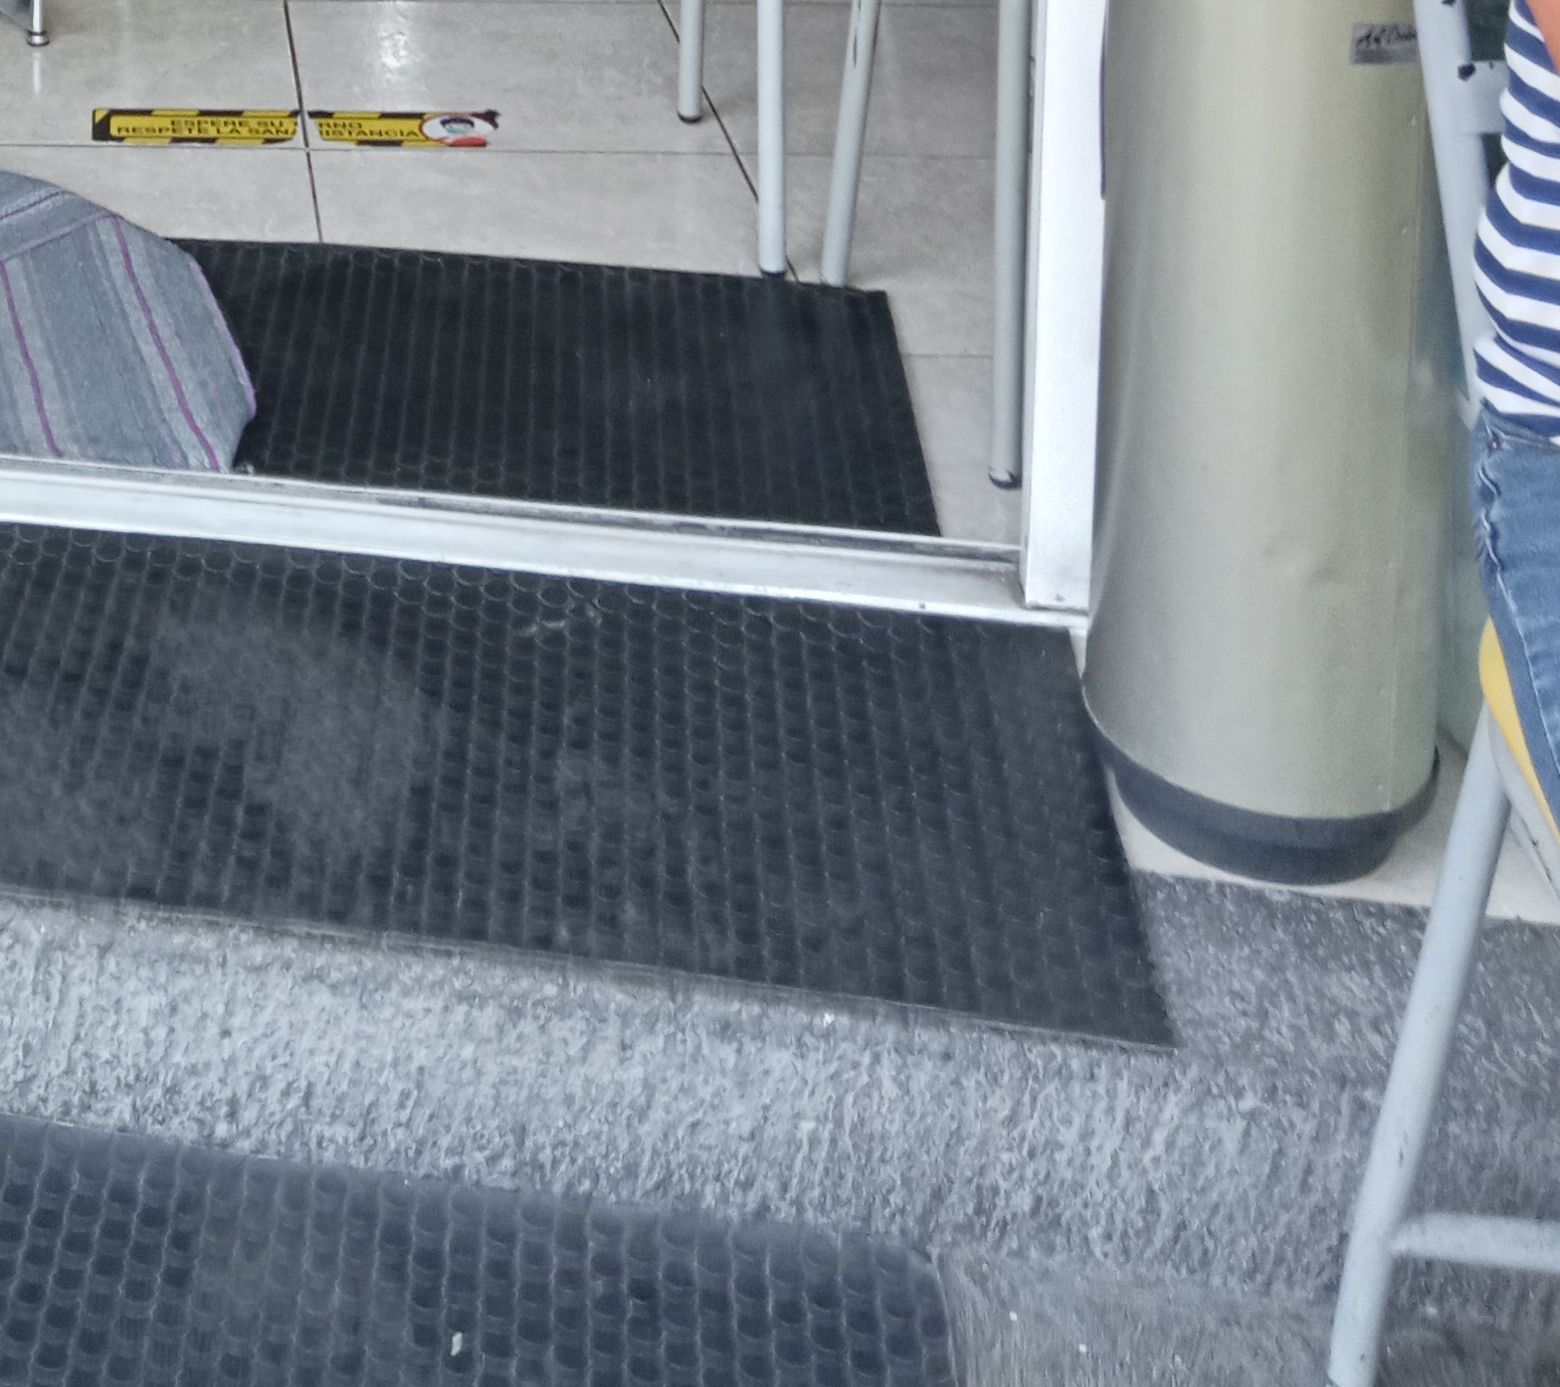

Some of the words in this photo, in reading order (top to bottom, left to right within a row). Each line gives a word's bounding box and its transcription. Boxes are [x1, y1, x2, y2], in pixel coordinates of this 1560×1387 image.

[170, 119, 250, 128] ESPERE
[256, 120, 285, 128] SU
[117, 126, 210, 135] RESPETE
[216, 127, 241, 135] LA
